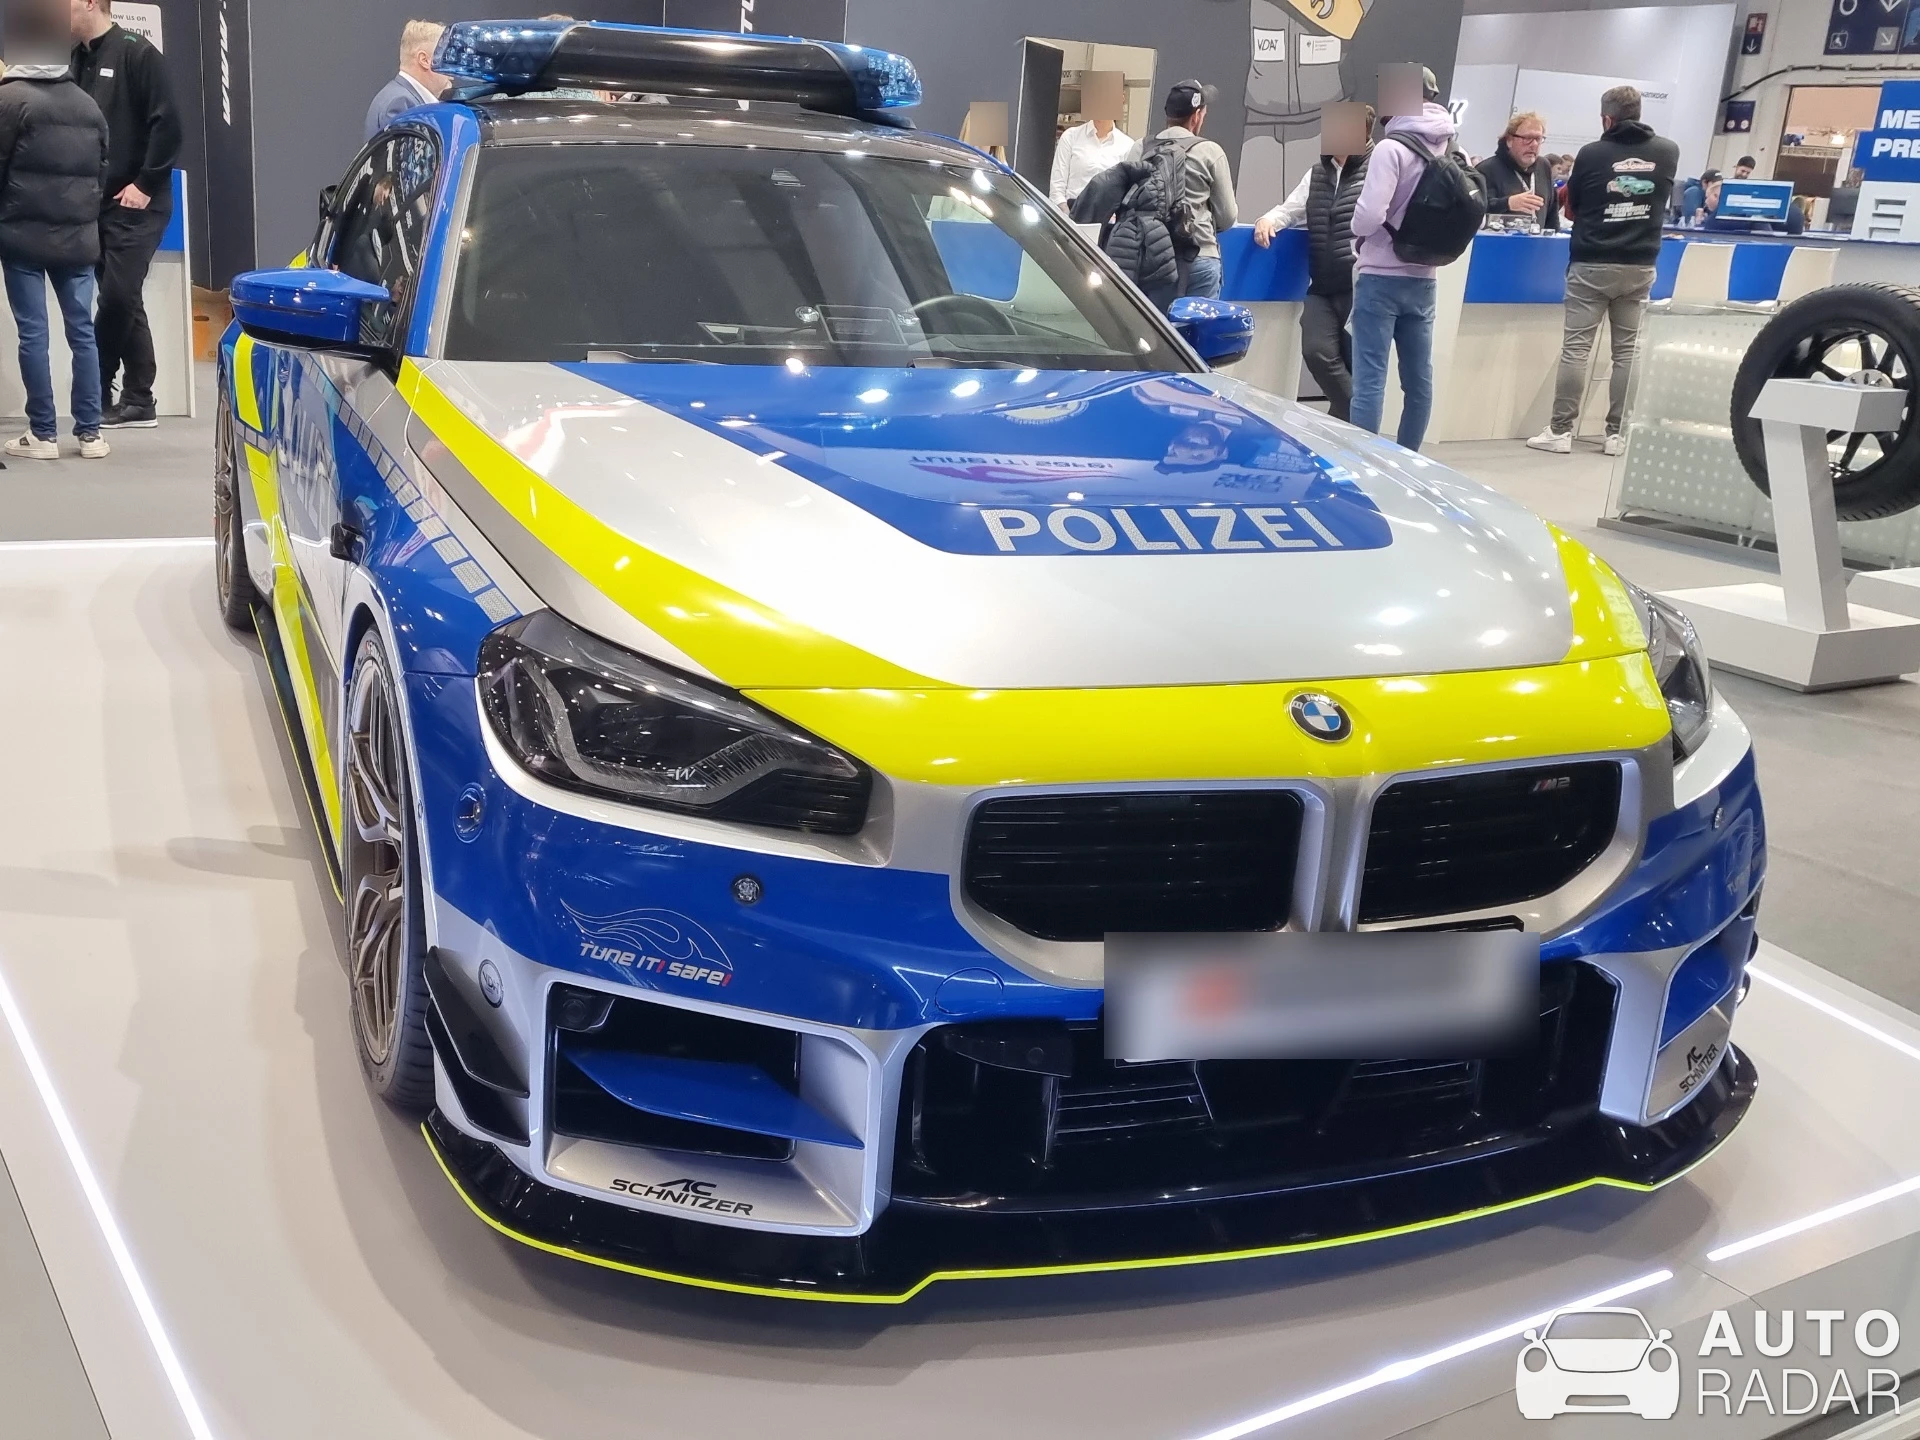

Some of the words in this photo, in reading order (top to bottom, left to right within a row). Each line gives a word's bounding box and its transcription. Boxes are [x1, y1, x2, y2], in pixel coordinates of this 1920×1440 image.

[110, 12, 125, 20] low
[1257, 38, 1279, 51] VDAT
[979, 507, 1344, 551] POLIZEI
[636, 954, 665, 974] IT!
[1679, 1043, 1719, 1093] SCHNITZER
[1687, 1045, 1703, 1071] AC
[609, 1178, 754, 1216] SCHNITZER
[655, 1178, 717, 1197] AC
